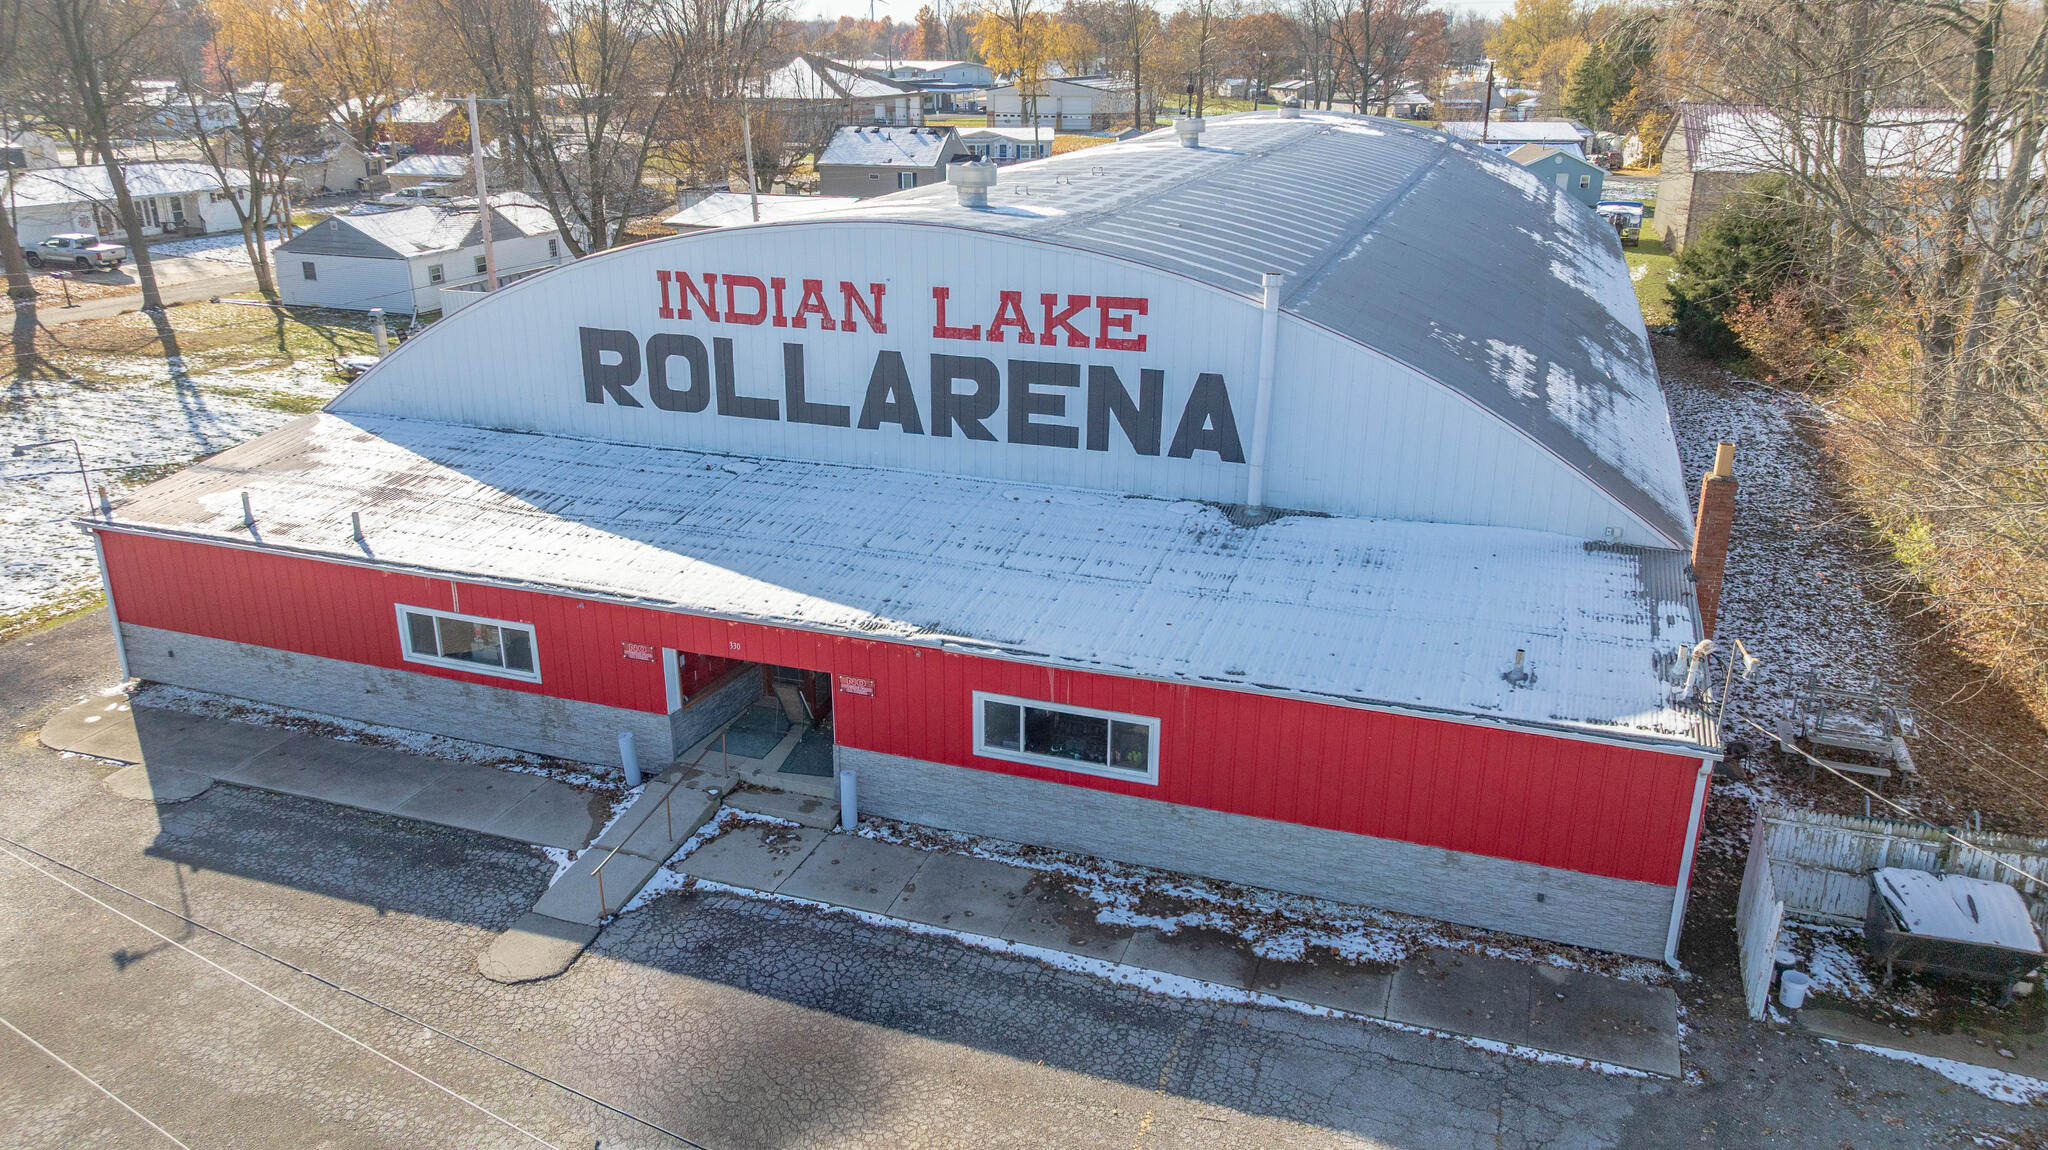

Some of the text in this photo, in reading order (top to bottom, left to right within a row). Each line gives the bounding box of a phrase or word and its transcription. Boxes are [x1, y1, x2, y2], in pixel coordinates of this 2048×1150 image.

[657, 271, 1149, 352] INDIAN LAKE
[579, 326, 1246, 465] ROLLARENA
[628, 643, 647, 653] NO
[728, 641, 741, 651] 330
[847, 677, 867, 687] NO
